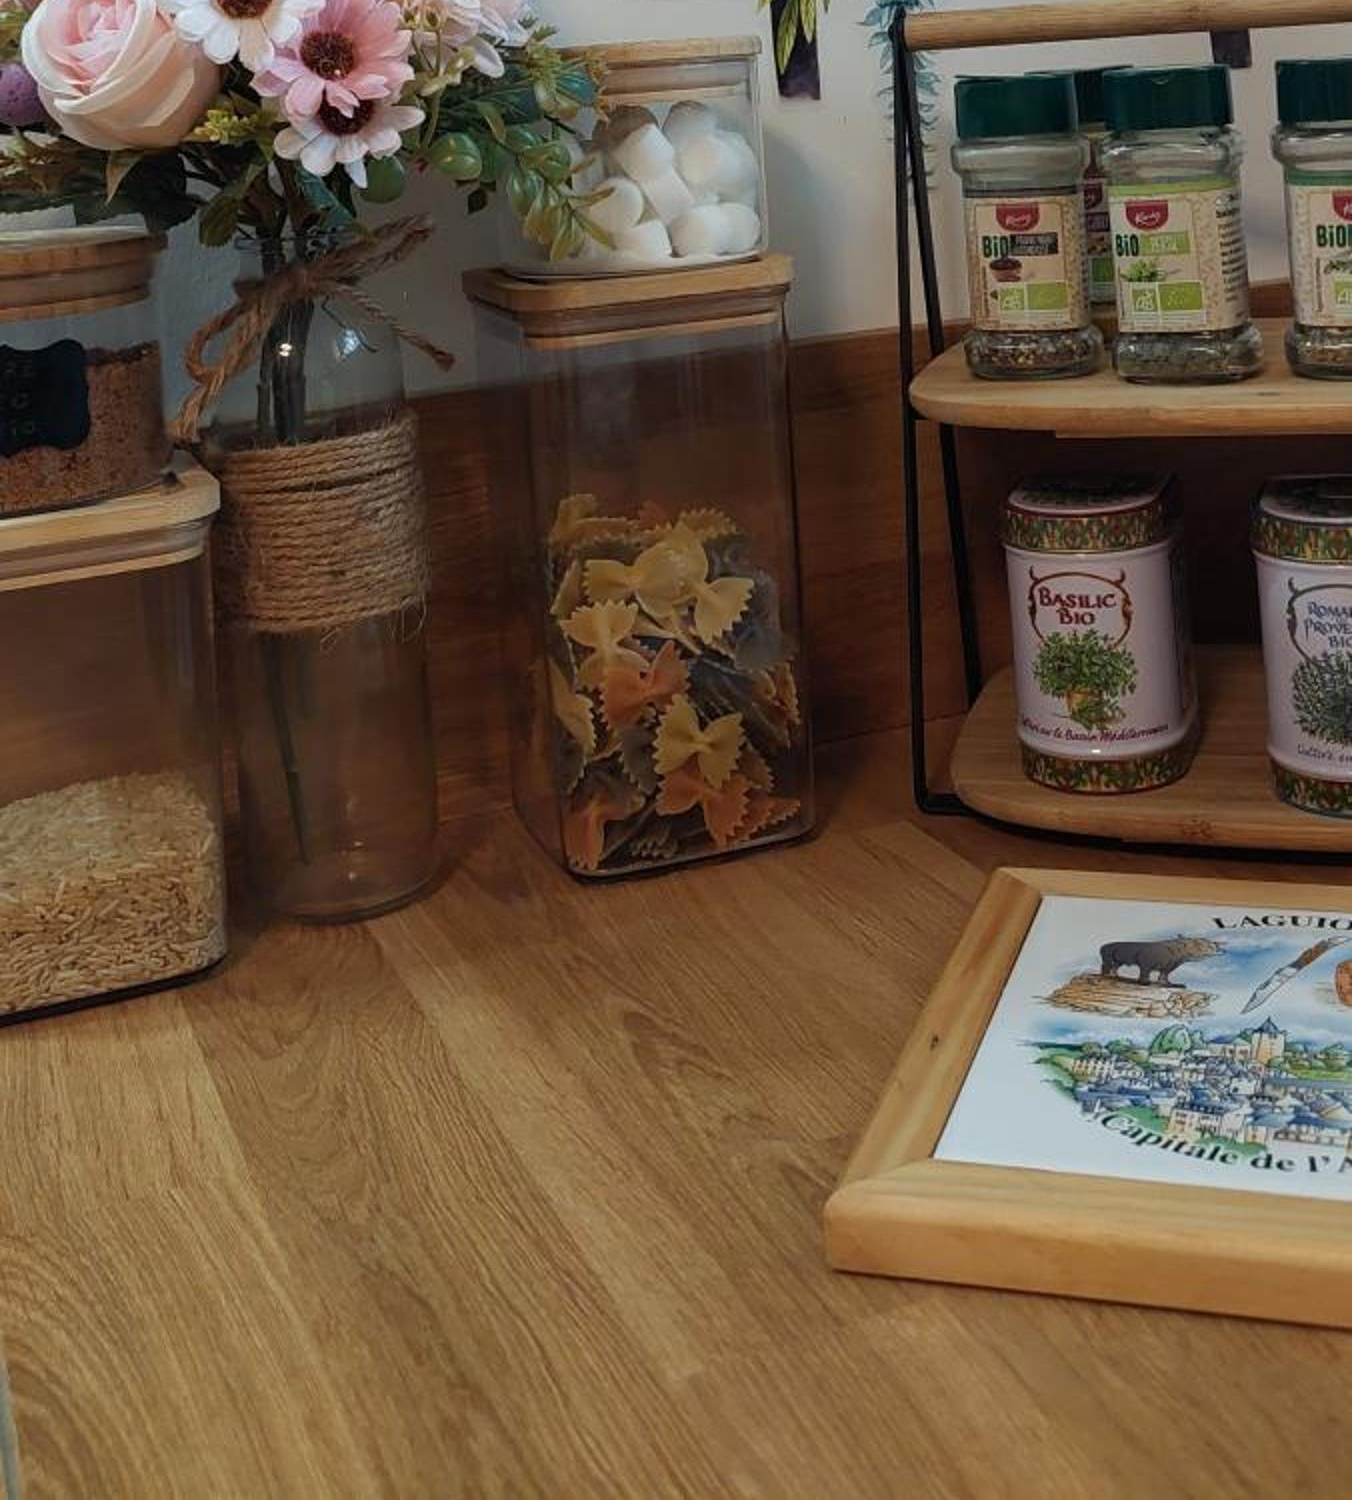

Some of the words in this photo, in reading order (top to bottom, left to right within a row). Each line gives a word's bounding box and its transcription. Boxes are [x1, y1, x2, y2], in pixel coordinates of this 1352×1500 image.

[1038, 586, 1117, 609] BASILIC
[1056, 607, 1096, 625] BIO
[1212, 914, 1352, 931] LAGUIO
[1101, 1113, 1239, 1166] Capitale
[1250, 1153, 1295, 1172] de
